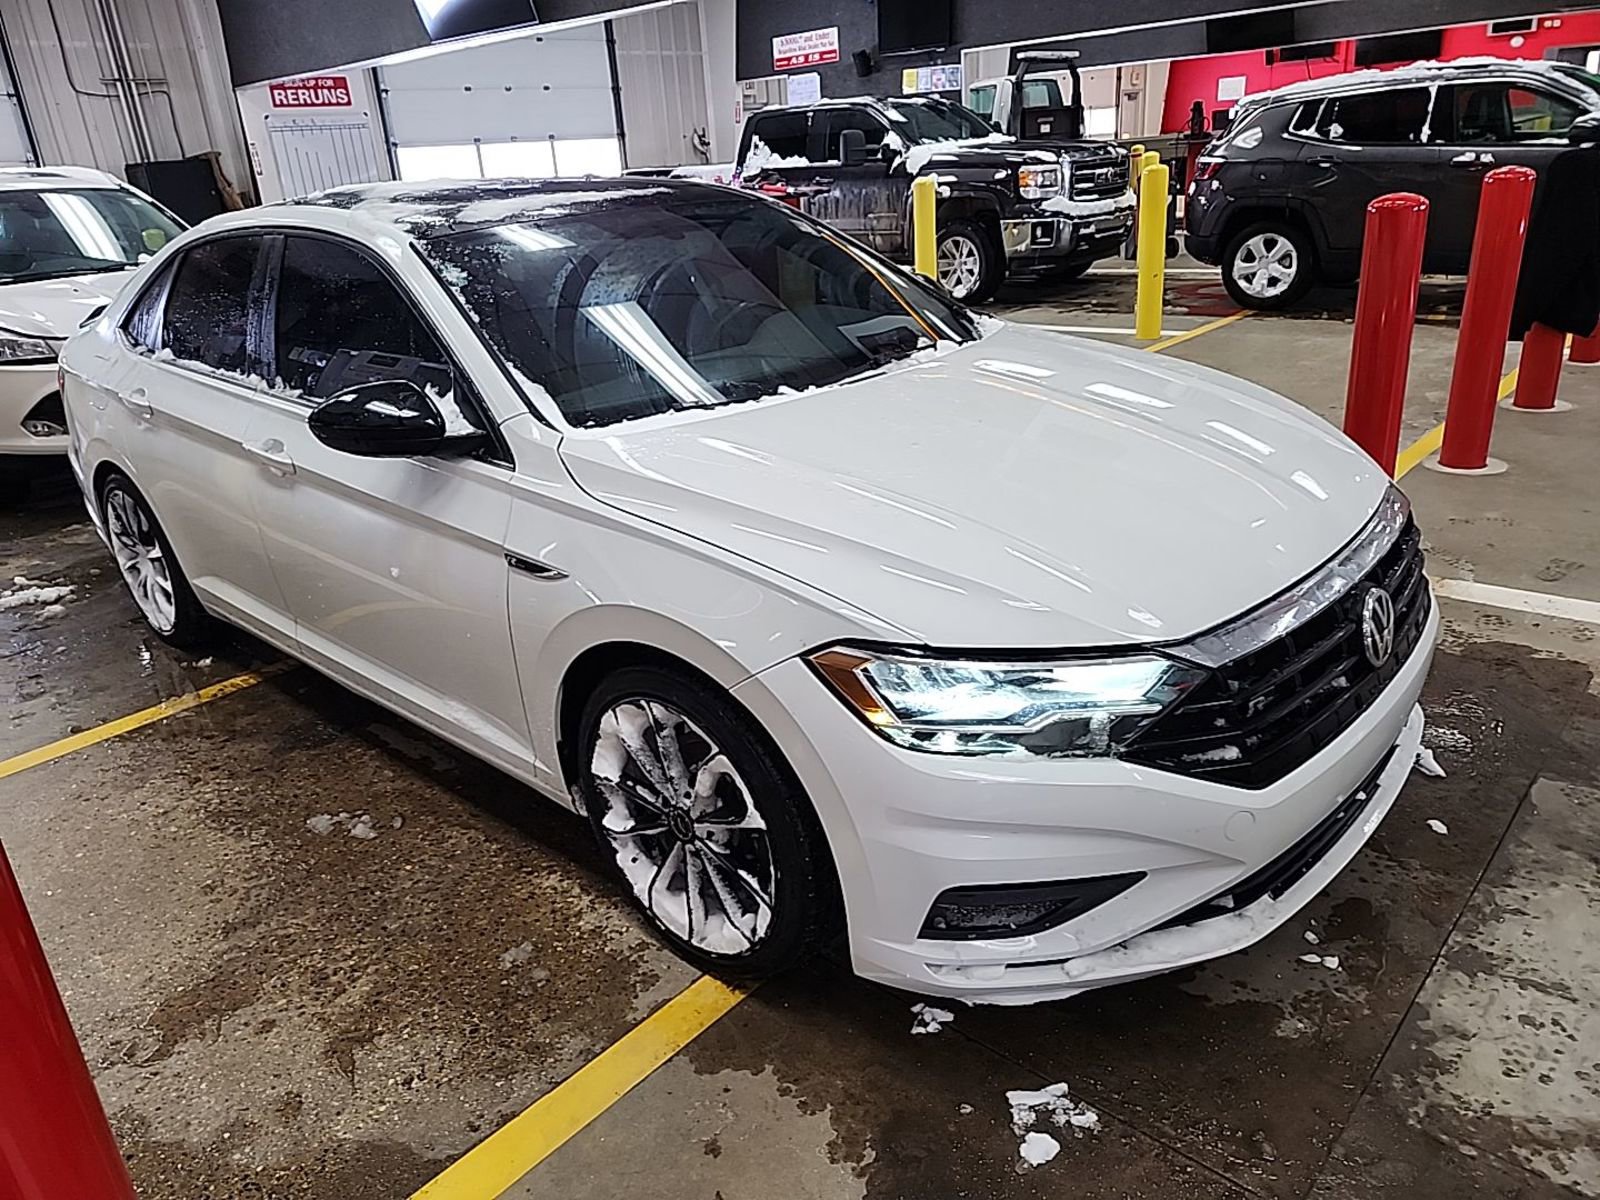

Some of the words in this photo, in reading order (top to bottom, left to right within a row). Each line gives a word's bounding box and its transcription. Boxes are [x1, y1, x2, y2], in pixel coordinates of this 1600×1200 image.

[790, 55, 805, 65] AS
[808, 52, 820, 62] IS
[318, 79, 335, 87] FOR
[273, 88, 348, 105] RERUNS
